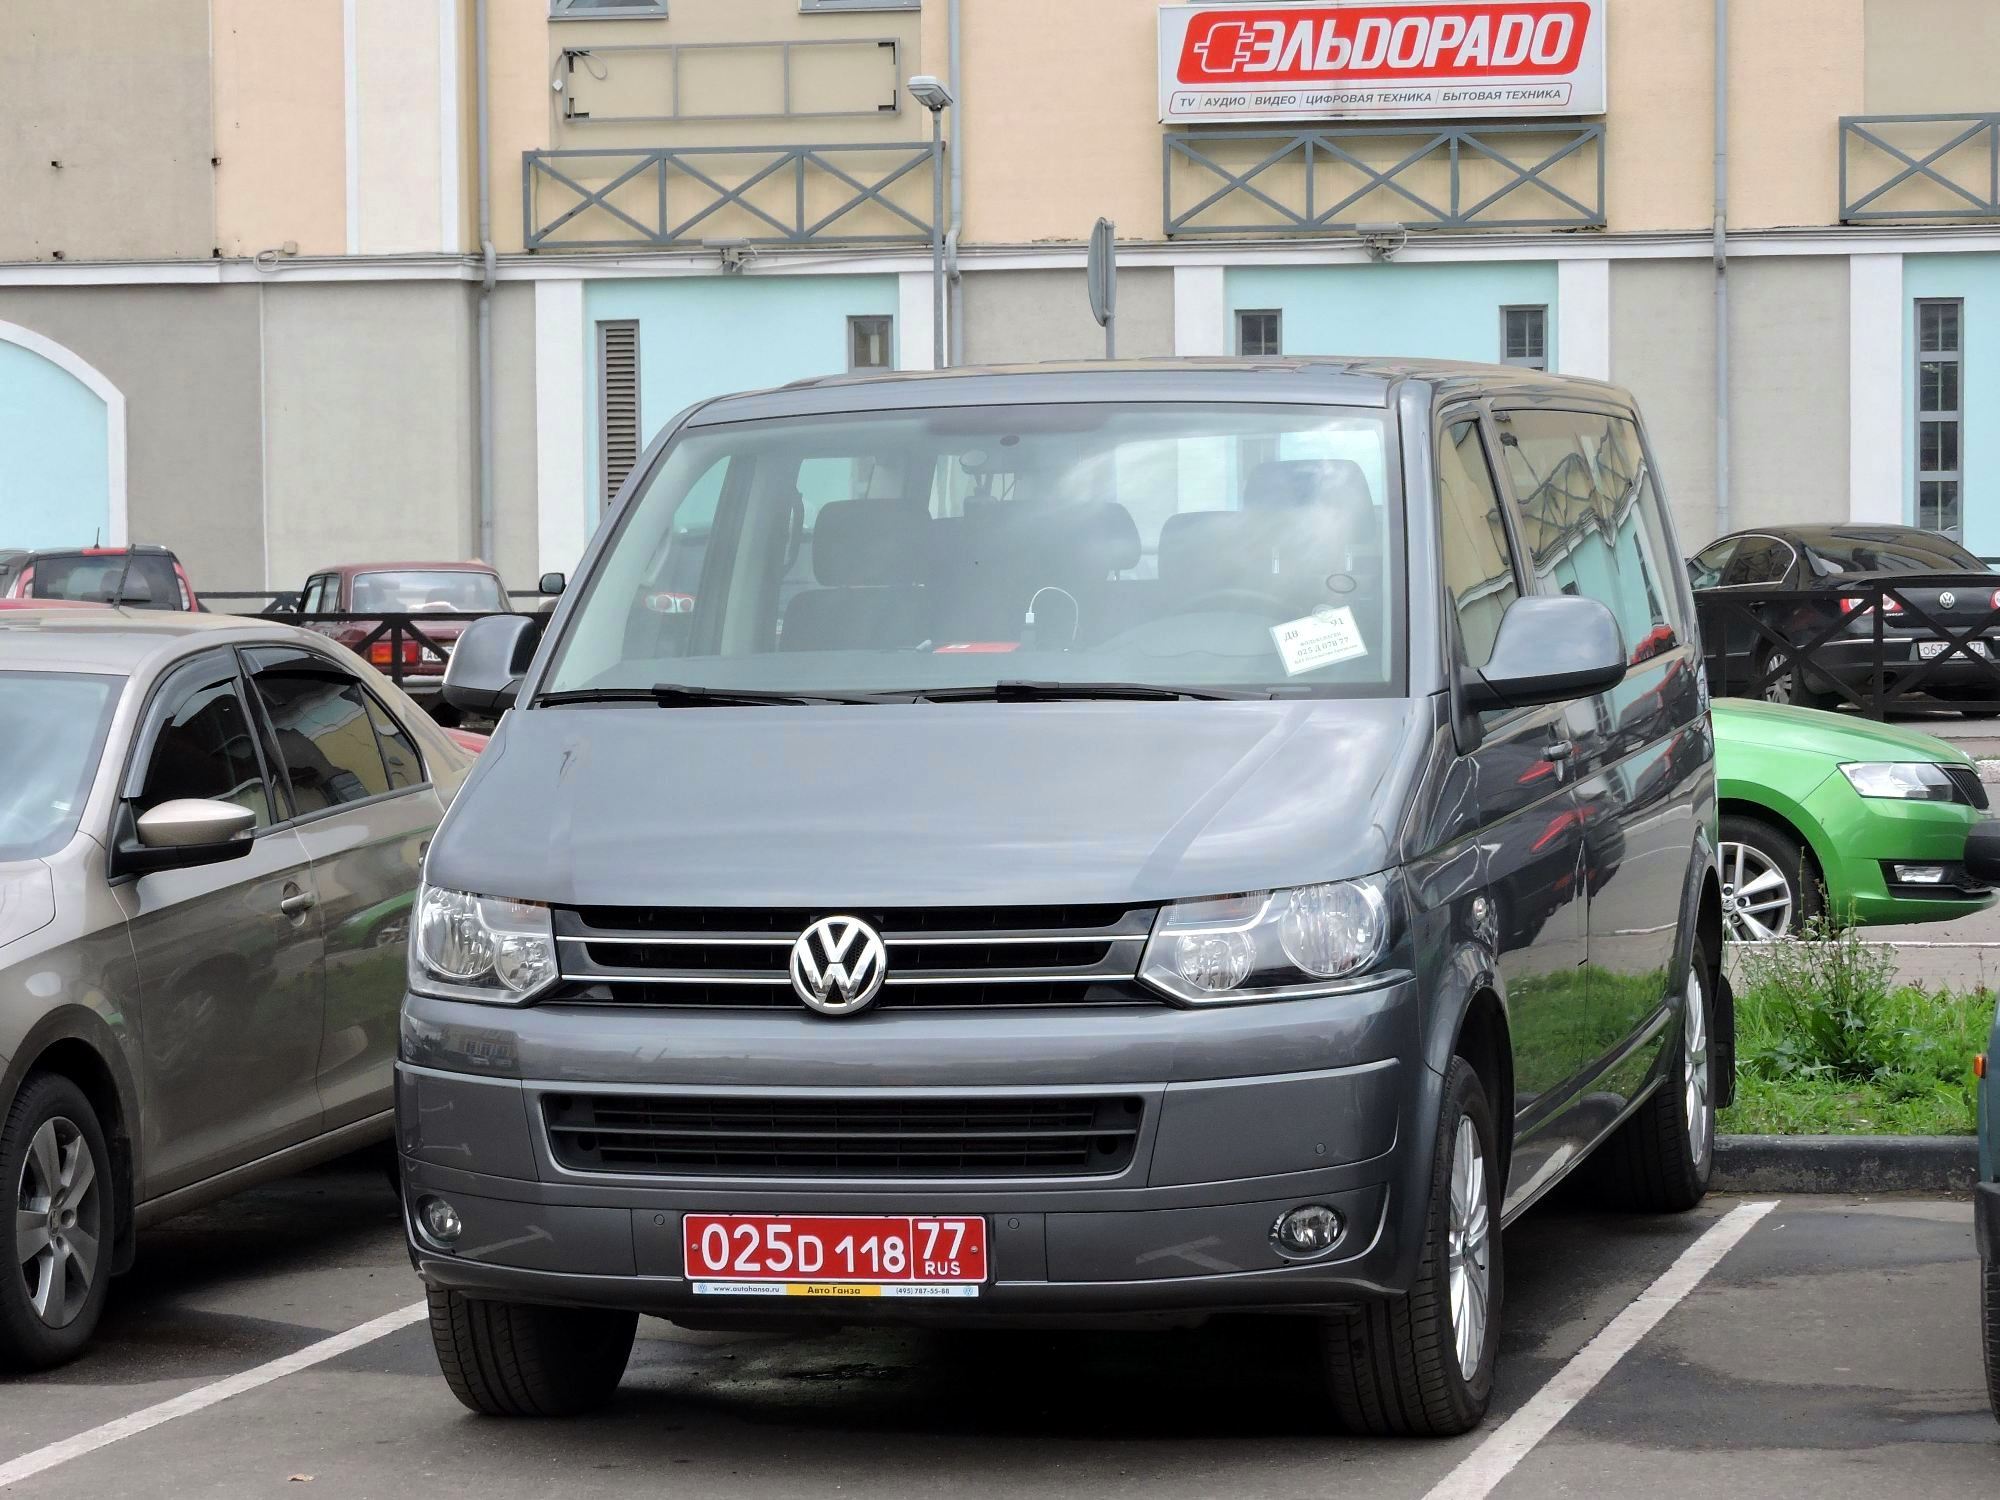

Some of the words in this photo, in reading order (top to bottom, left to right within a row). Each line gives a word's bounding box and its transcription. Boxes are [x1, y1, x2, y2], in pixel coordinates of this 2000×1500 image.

[1180, 98, 1195, 107] TV
[1204, 97, 1246, 107] АУДИО
[1255, 95, 1296, 106] ВИДЕО
[1306, 94, 1374, 105] ЦИФРОВАЯ
[1377, 92, 1432, 102] ТЕХНИКА
[1442, 91, 1502, 101] БЫТОВАЯ
[1505, 89, 1561, 100] ТЕХНИКА
[834, 1236, 906, 1273] 118
[917, 1222, 966, 1259] 77
[925, 1261, 961, 1275] RUS
[807, 1286, 830, 1294] Авто
[832, 1287, 861, 1295] Ганза
